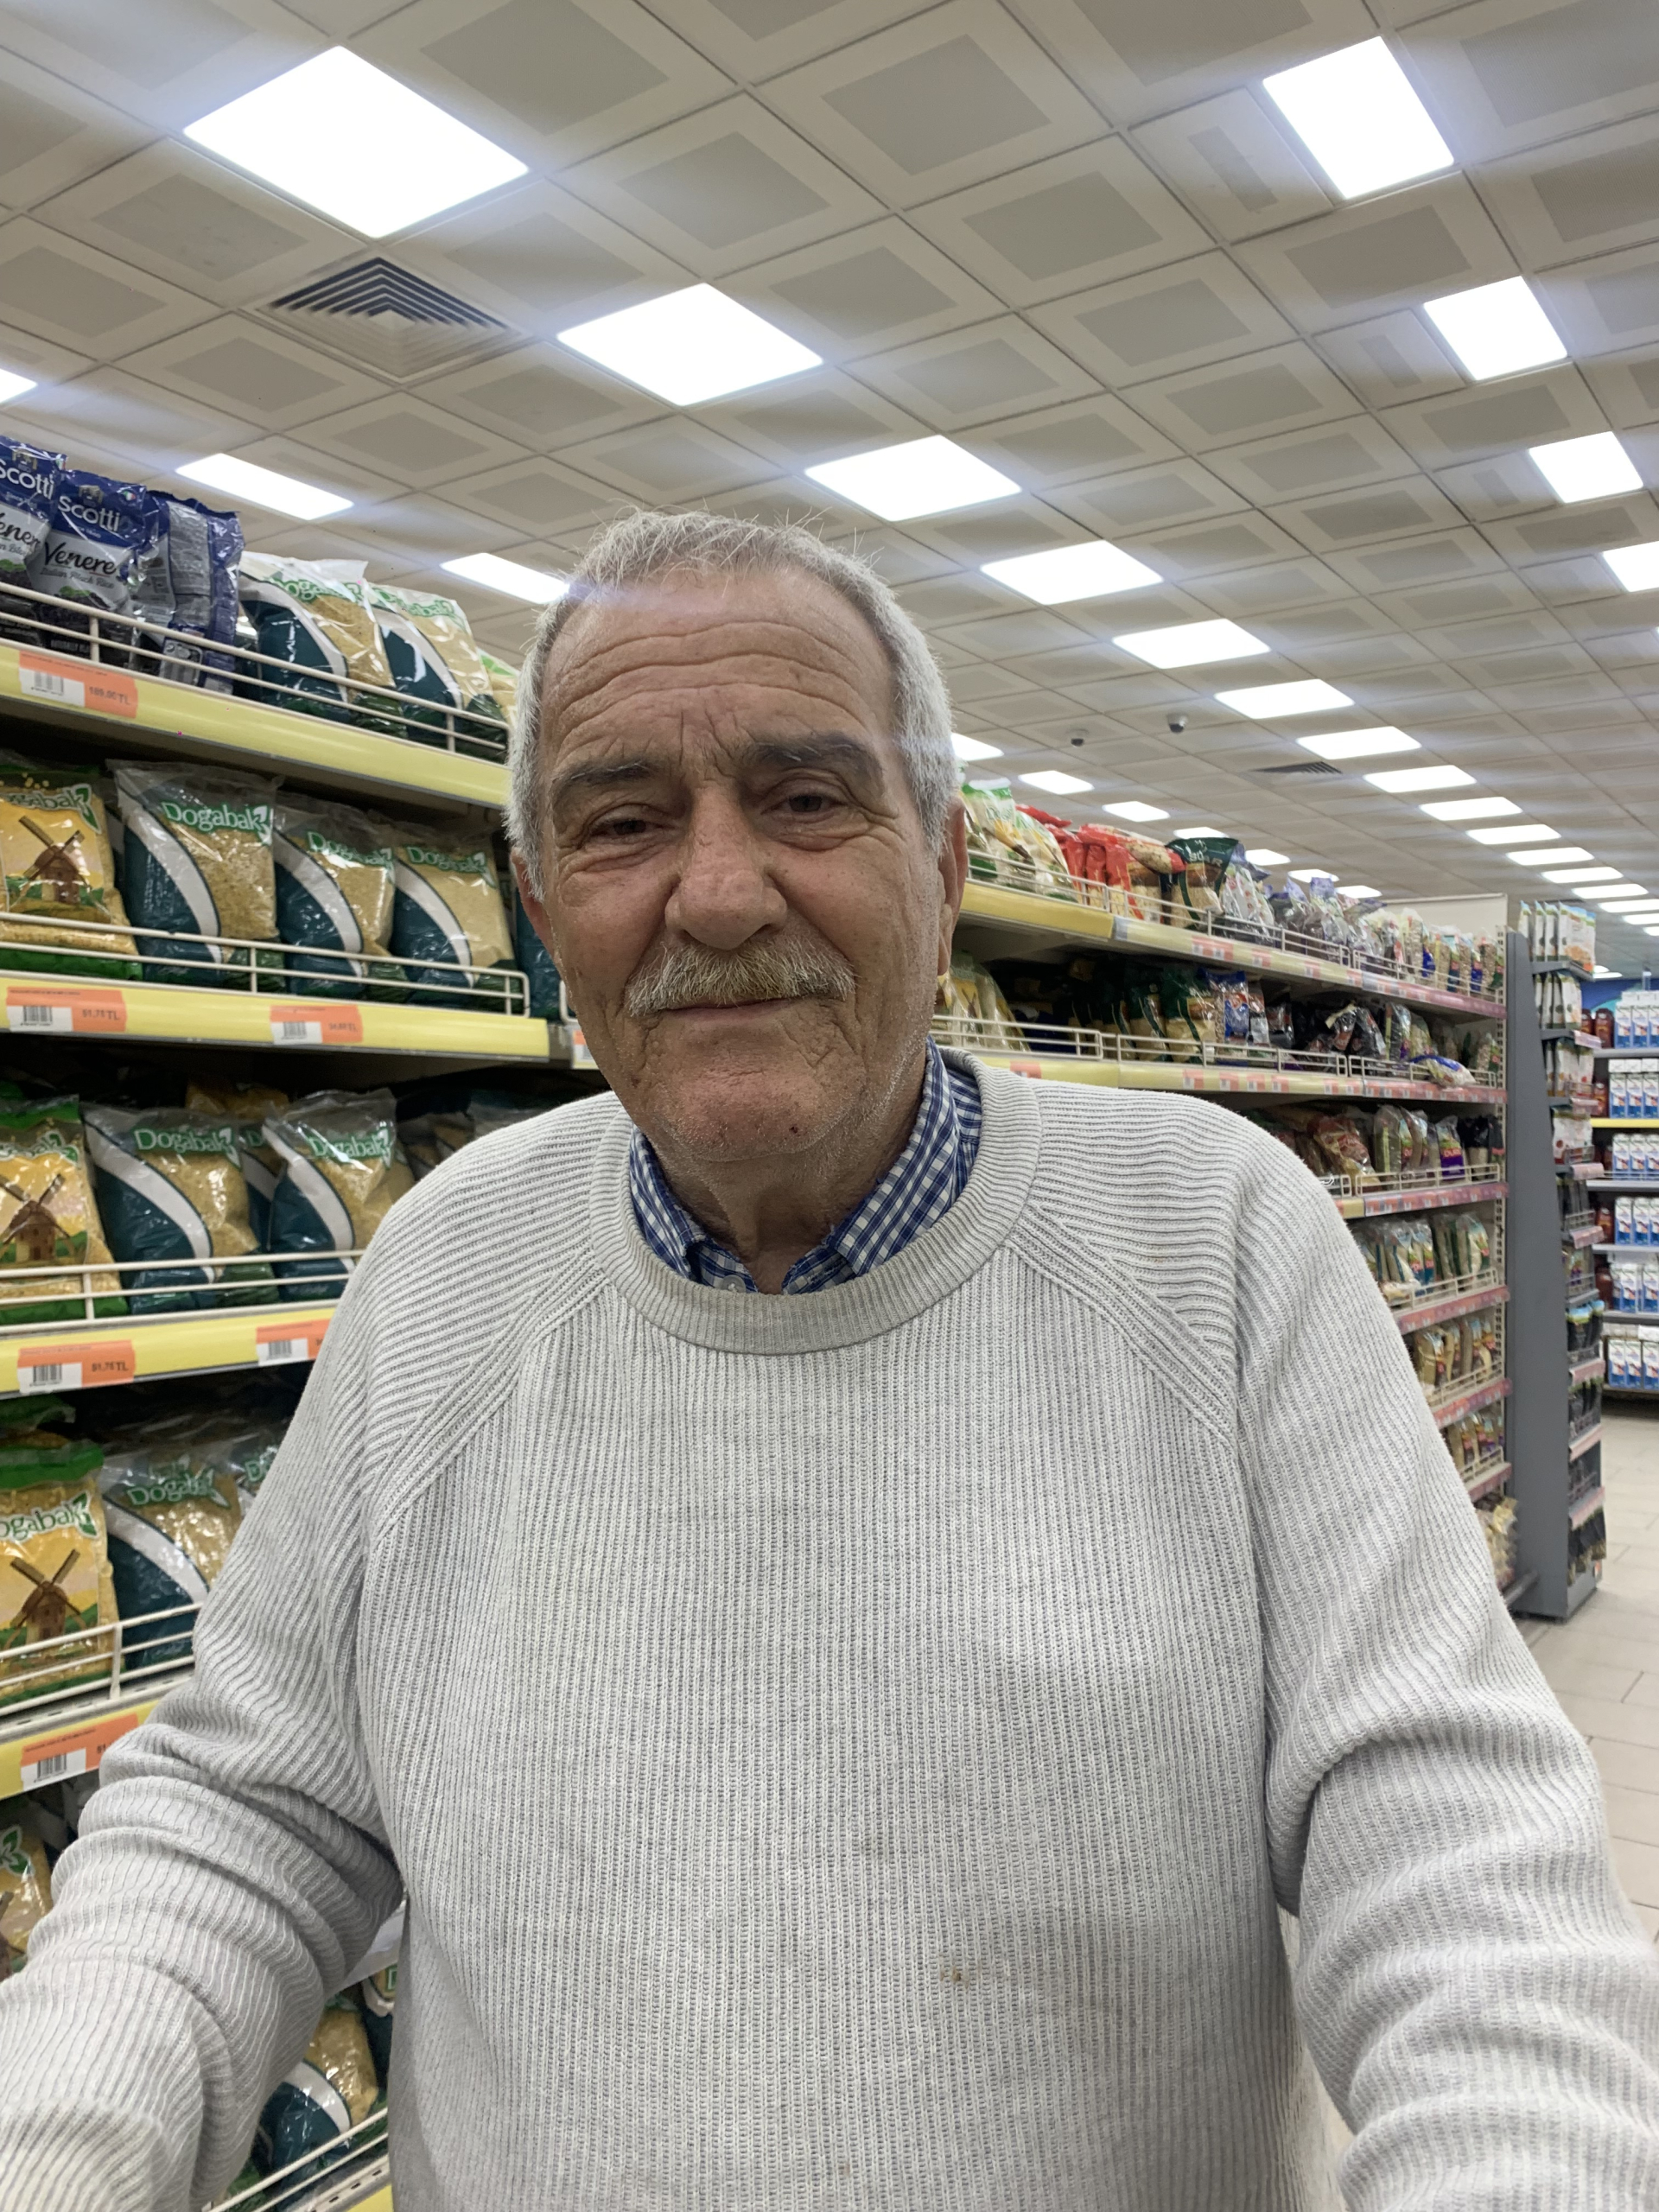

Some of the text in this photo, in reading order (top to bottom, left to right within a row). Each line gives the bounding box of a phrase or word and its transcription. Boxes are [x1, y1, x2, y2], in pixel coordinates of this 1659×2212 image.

[58, 495, 121, 532] Scotti
[0, 513, 40, 549] ener
[44, 541, 117, 575] Venere
[162, 802, 264, 831] Dogabak
[134, 1128, 233, 1154] Dogabak
[116, 1360, 130, 1372] TL
[0, 1500, 86, 1541] ogabak
